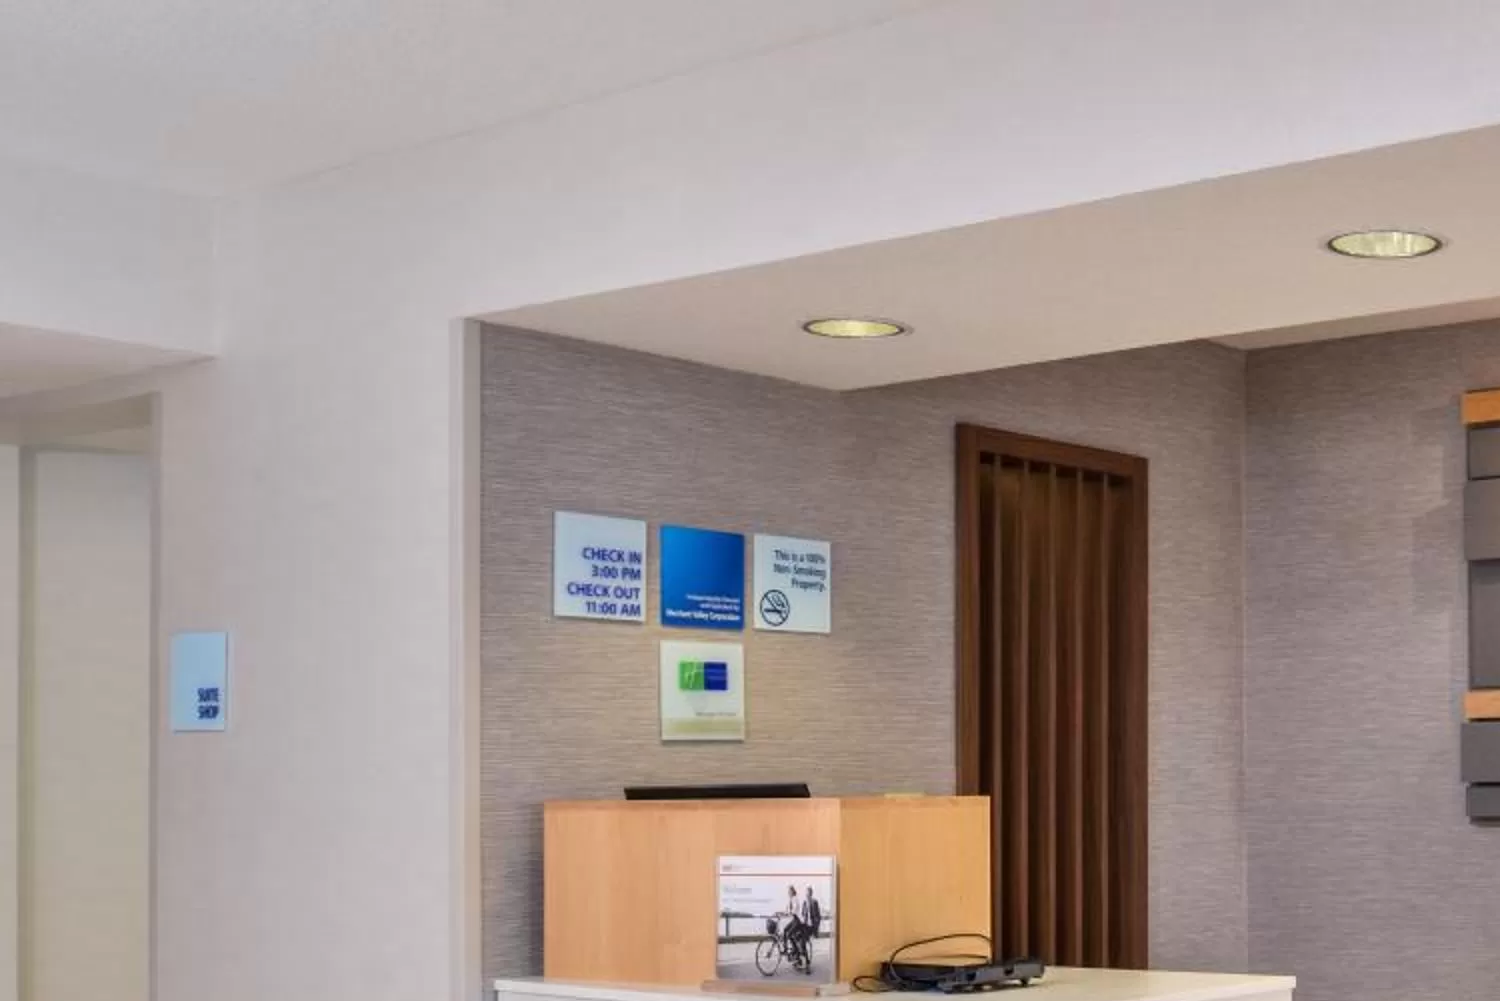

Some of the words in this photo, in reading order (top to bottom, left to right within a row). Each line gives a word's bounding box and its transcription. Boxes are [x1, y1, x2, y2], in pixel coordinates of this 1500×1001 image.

[582, 547, 625, 563] CHECK
[628, 550, 642, 565] IN
[773, 549, 790, 561] This
[591, 563, 619, 579] 3:00
[621, 566, 641, 581] PM
[567, 582, 611, 598] CHECK
[613, 585, 641, 600] OUT
[585, 600, 617, 615] 11:00
[620, 602, 641, 617] AM
